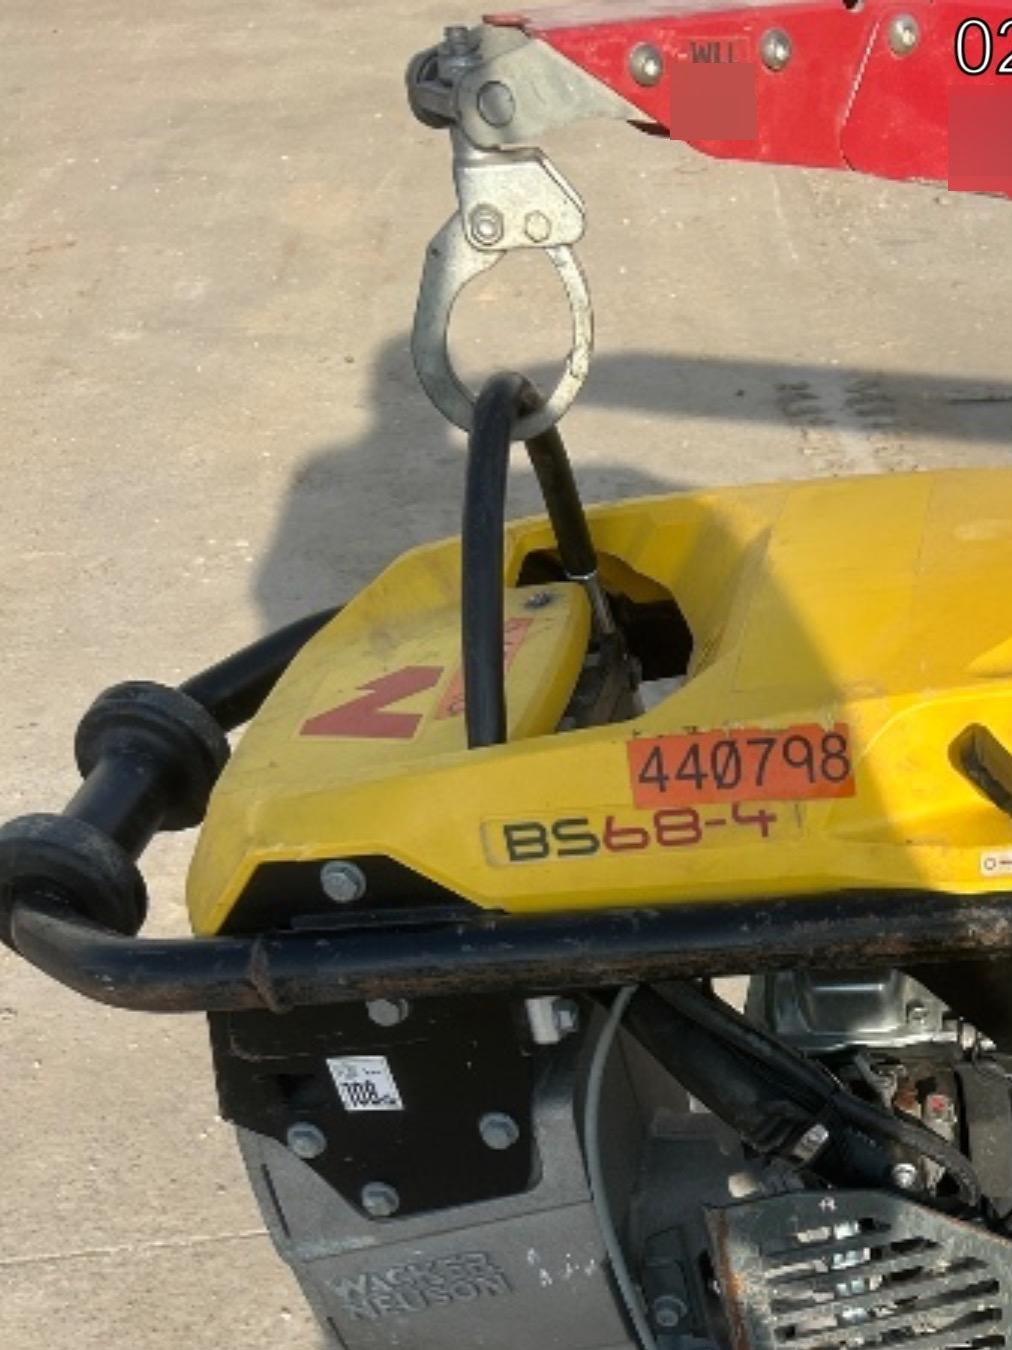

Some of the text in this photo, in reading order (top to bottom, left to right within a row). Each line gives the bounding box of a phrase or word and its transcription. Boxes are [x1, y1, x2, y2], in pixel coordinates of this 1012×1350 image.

[638, 732, 850, 792] 440798
[504, 801, 777, 861] BS68-4
[329, 1251, 501, 1301] WACKER
[345, 1269, 514, 1321] NEUSON
